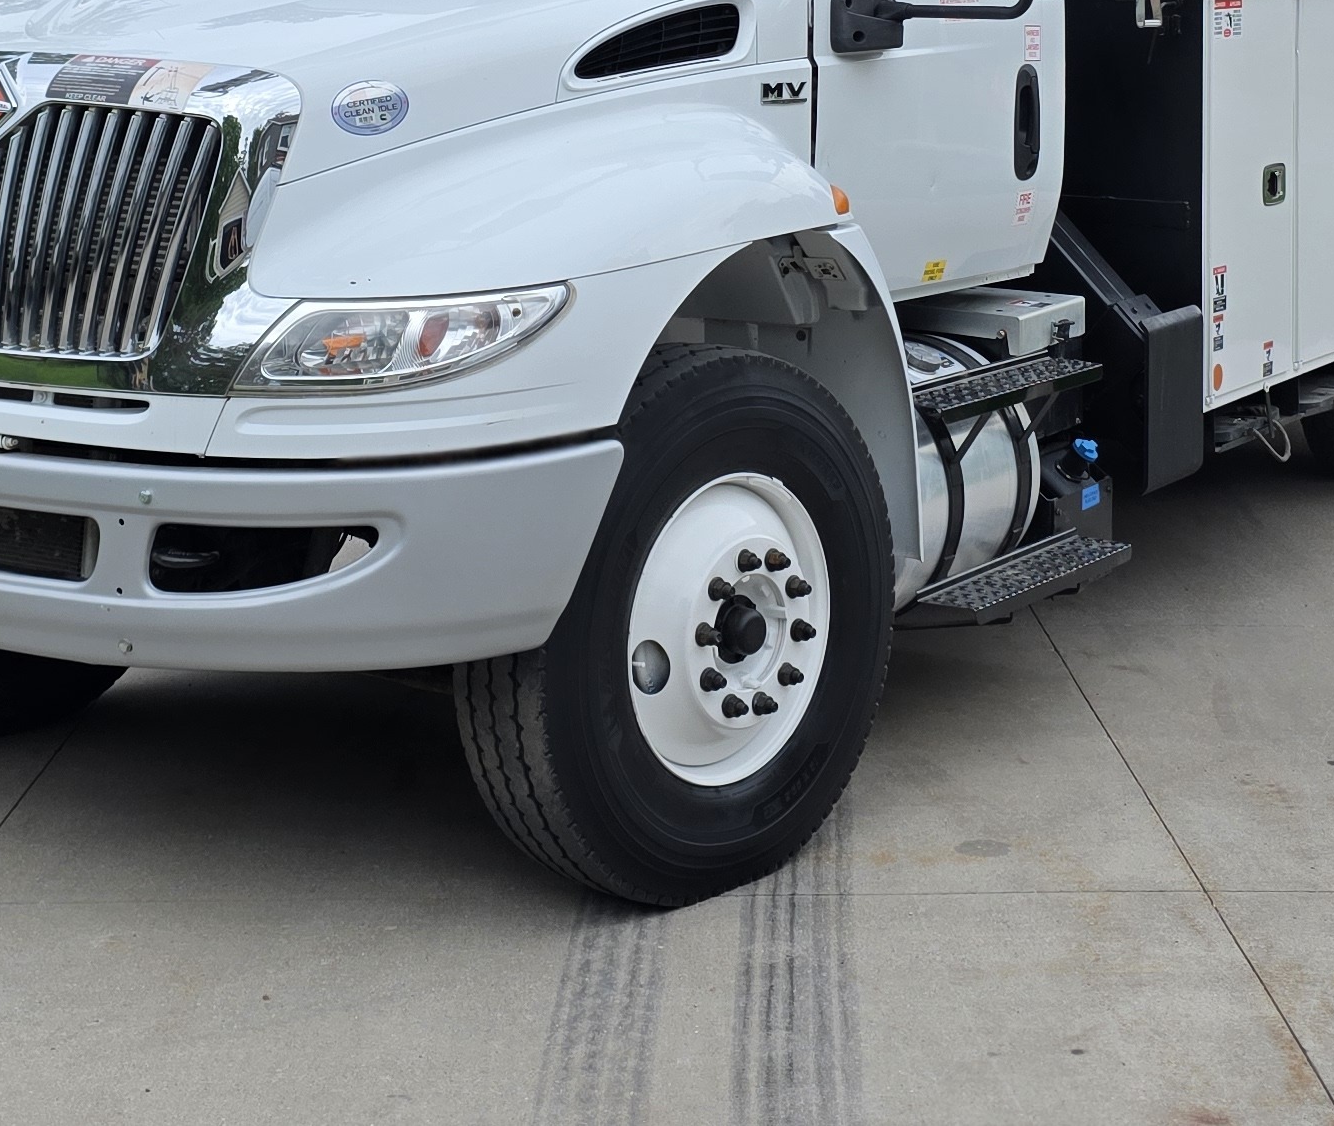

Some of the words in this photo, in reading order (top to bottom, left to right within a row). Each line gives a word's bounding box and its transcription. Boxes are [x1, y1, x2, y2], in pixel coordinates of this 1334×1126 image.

[95, 56, 147, 66] DANGER
[761, 81, 807, 98] MV
[65, 92, 84, 100] KEEP
[83, 93, 107, 102] CLEAR
[347, 95, 392, 108] CERTIFIED
[344, 107, 375, 118] CLEAN
[378, 103, 399, 113] IDLE
